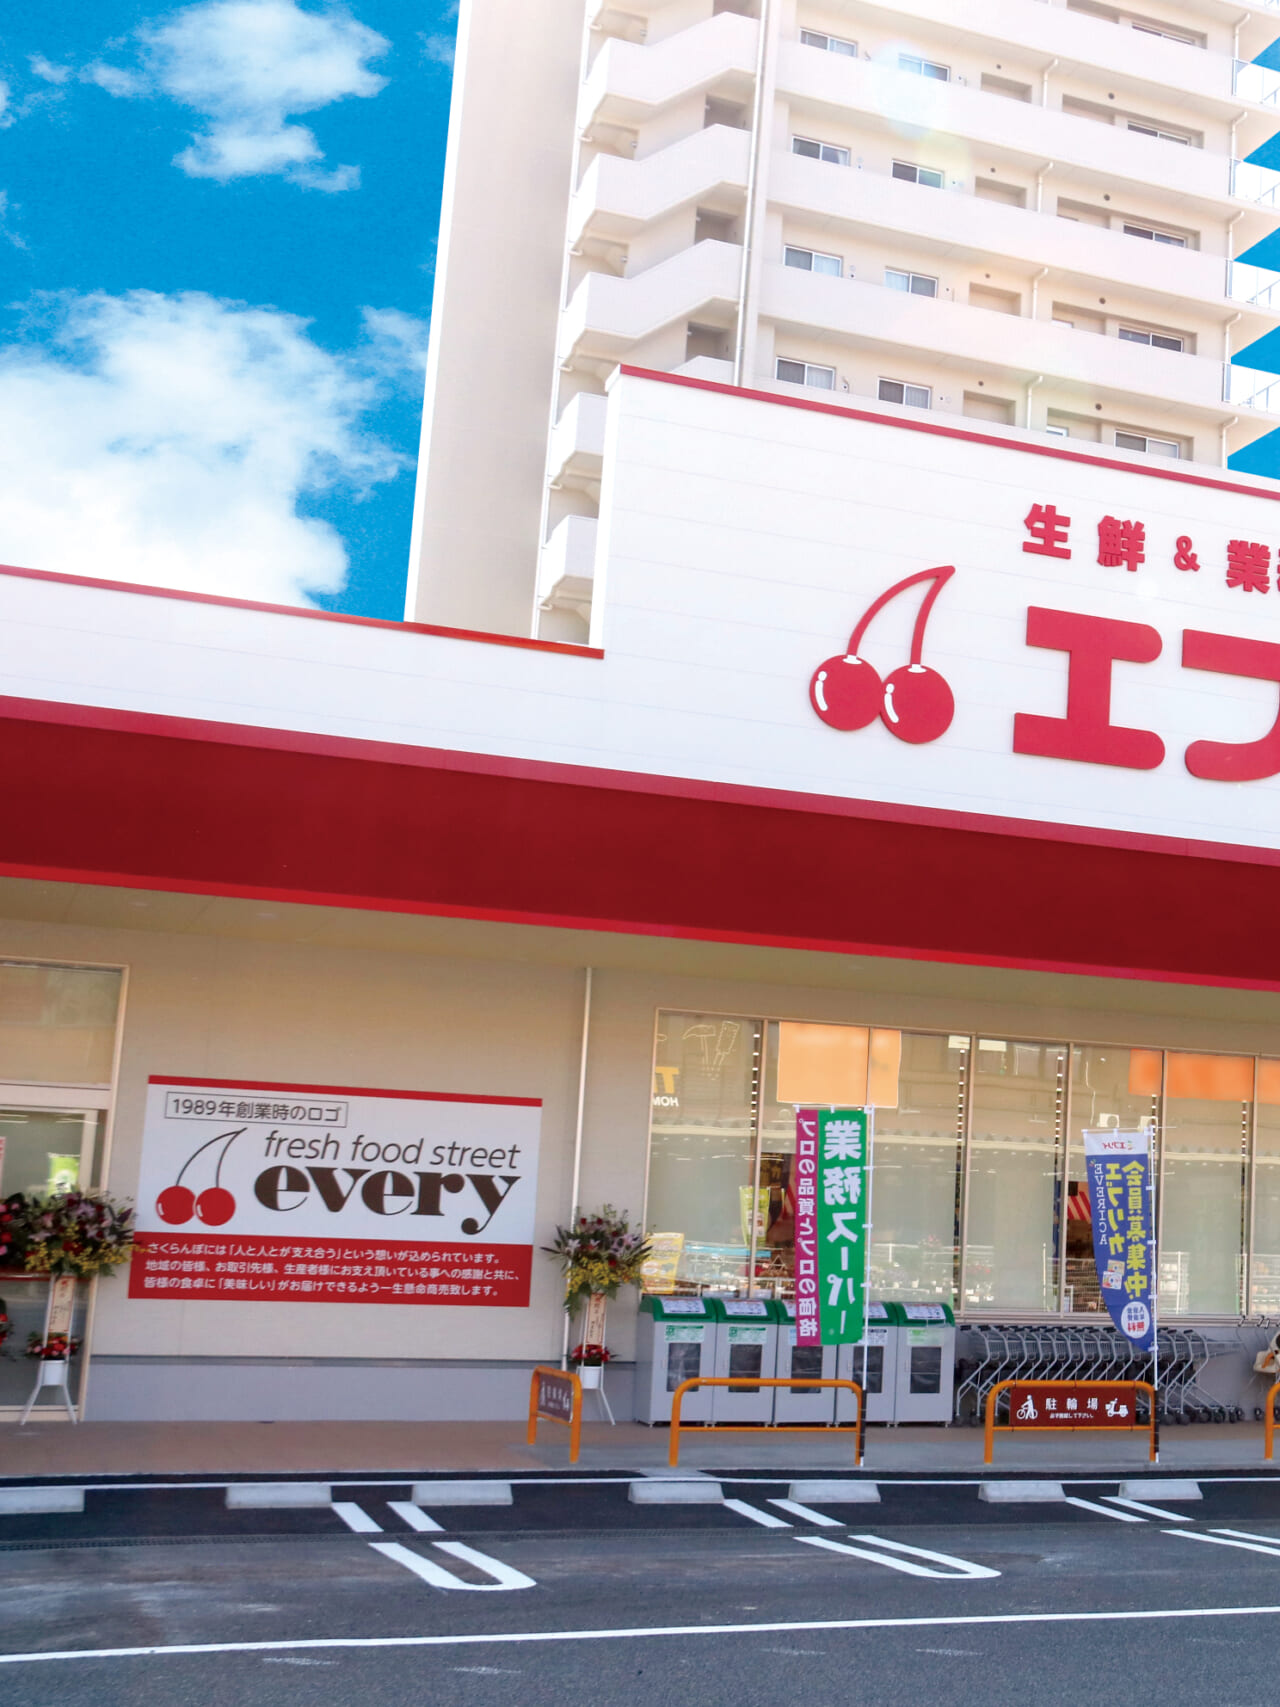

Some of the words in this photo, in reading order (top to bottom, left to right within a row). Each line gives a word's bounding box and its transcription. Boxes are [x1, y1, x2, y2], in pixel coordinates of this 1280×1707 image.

[1173, 535, 1200, 572] &
[172, 1098, 341, 1122] 1989年創業時のロゴ
[264, 1130, 341, 1160] fresh
[350, 1134, 424, 1165] food
[430, 1141, 521, 1169] street
[254, 1164, 522, 1236] every
[1045, 1397, 1098, 1410] 駐輪場
